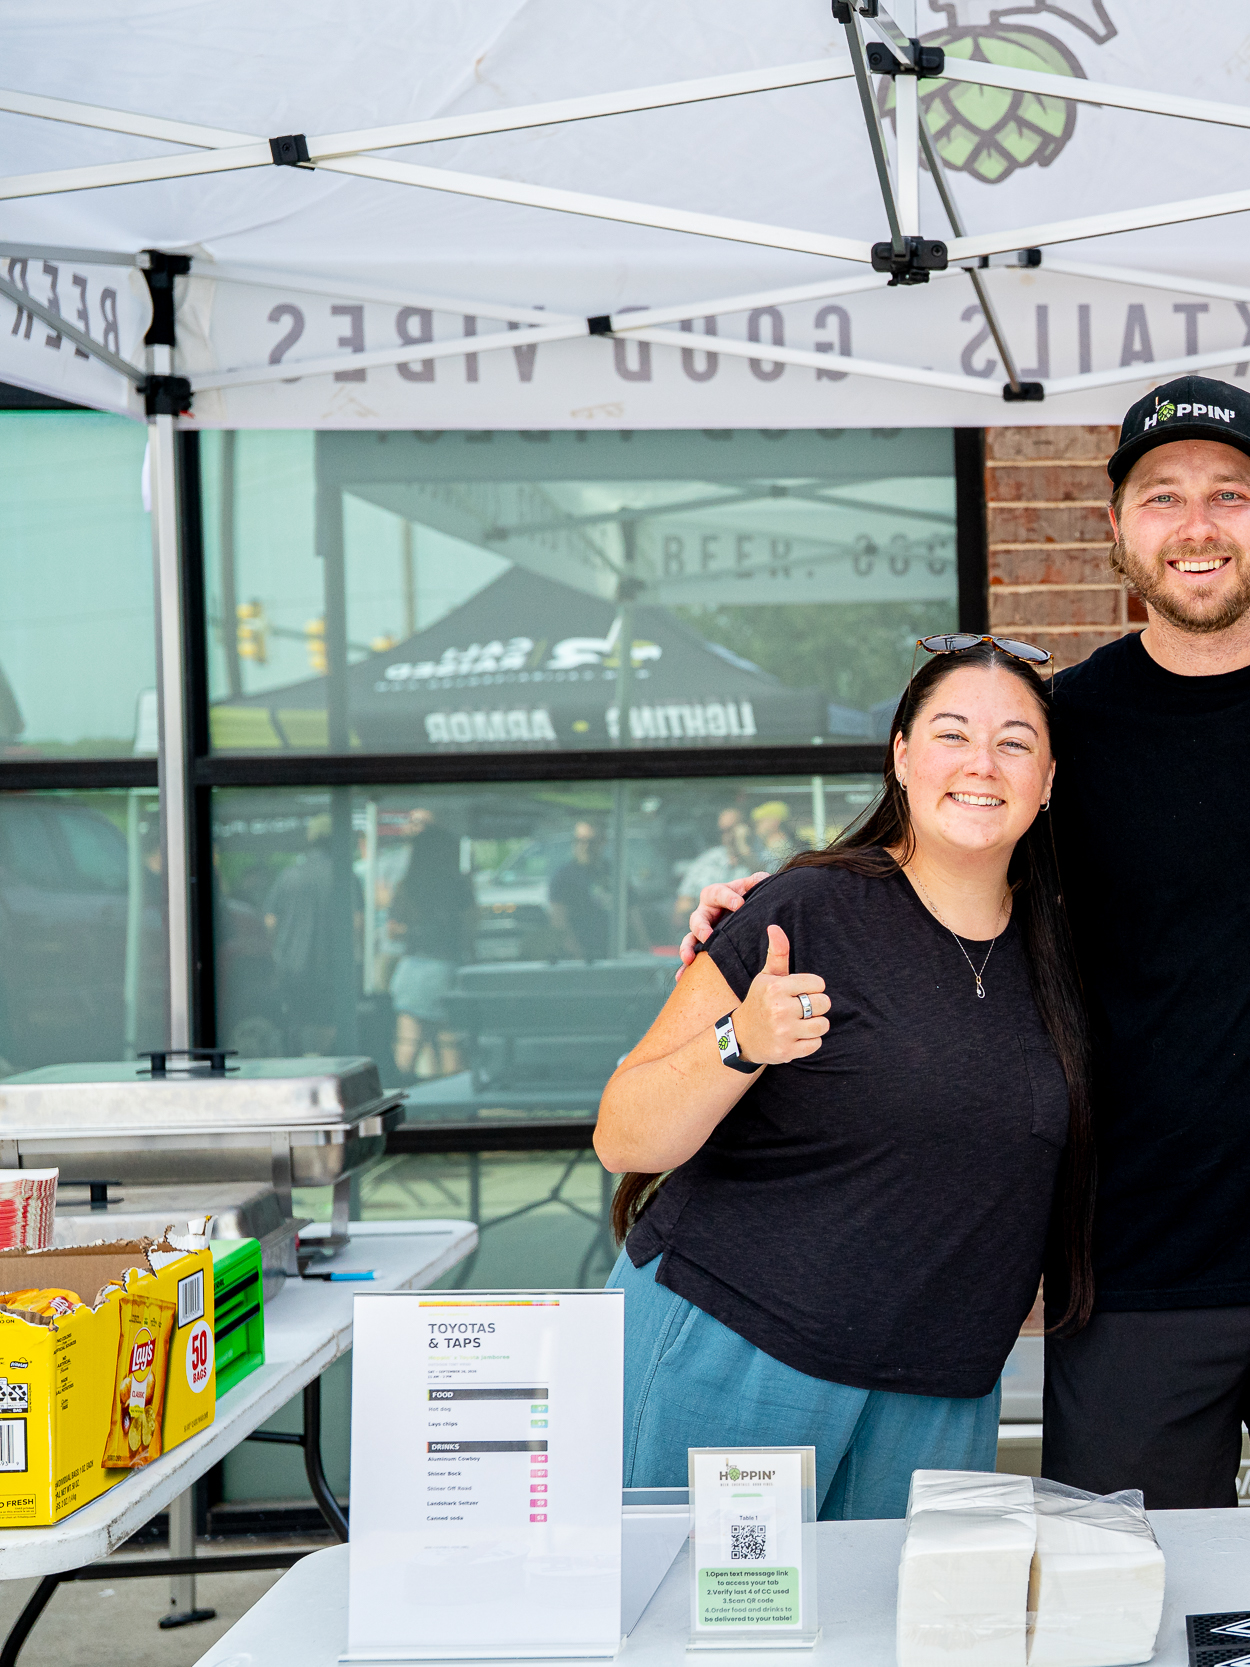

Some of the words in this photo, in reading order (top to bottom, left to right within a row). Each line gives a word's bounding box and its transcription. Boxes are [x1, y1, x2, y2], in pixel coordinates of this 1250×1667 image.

[428, 1323, 496, 1334] TOYOTAS
[428, 1339, 439, 1348] &
[444, 1337, 481, 1348] TAPS
[131, 1340, 154, 1371] Lay's
[191, 1329, 207, 1371] 50
[192, 1367, 207, 1384] BAGS
[6, 1498, 34, 1507] FRESH
